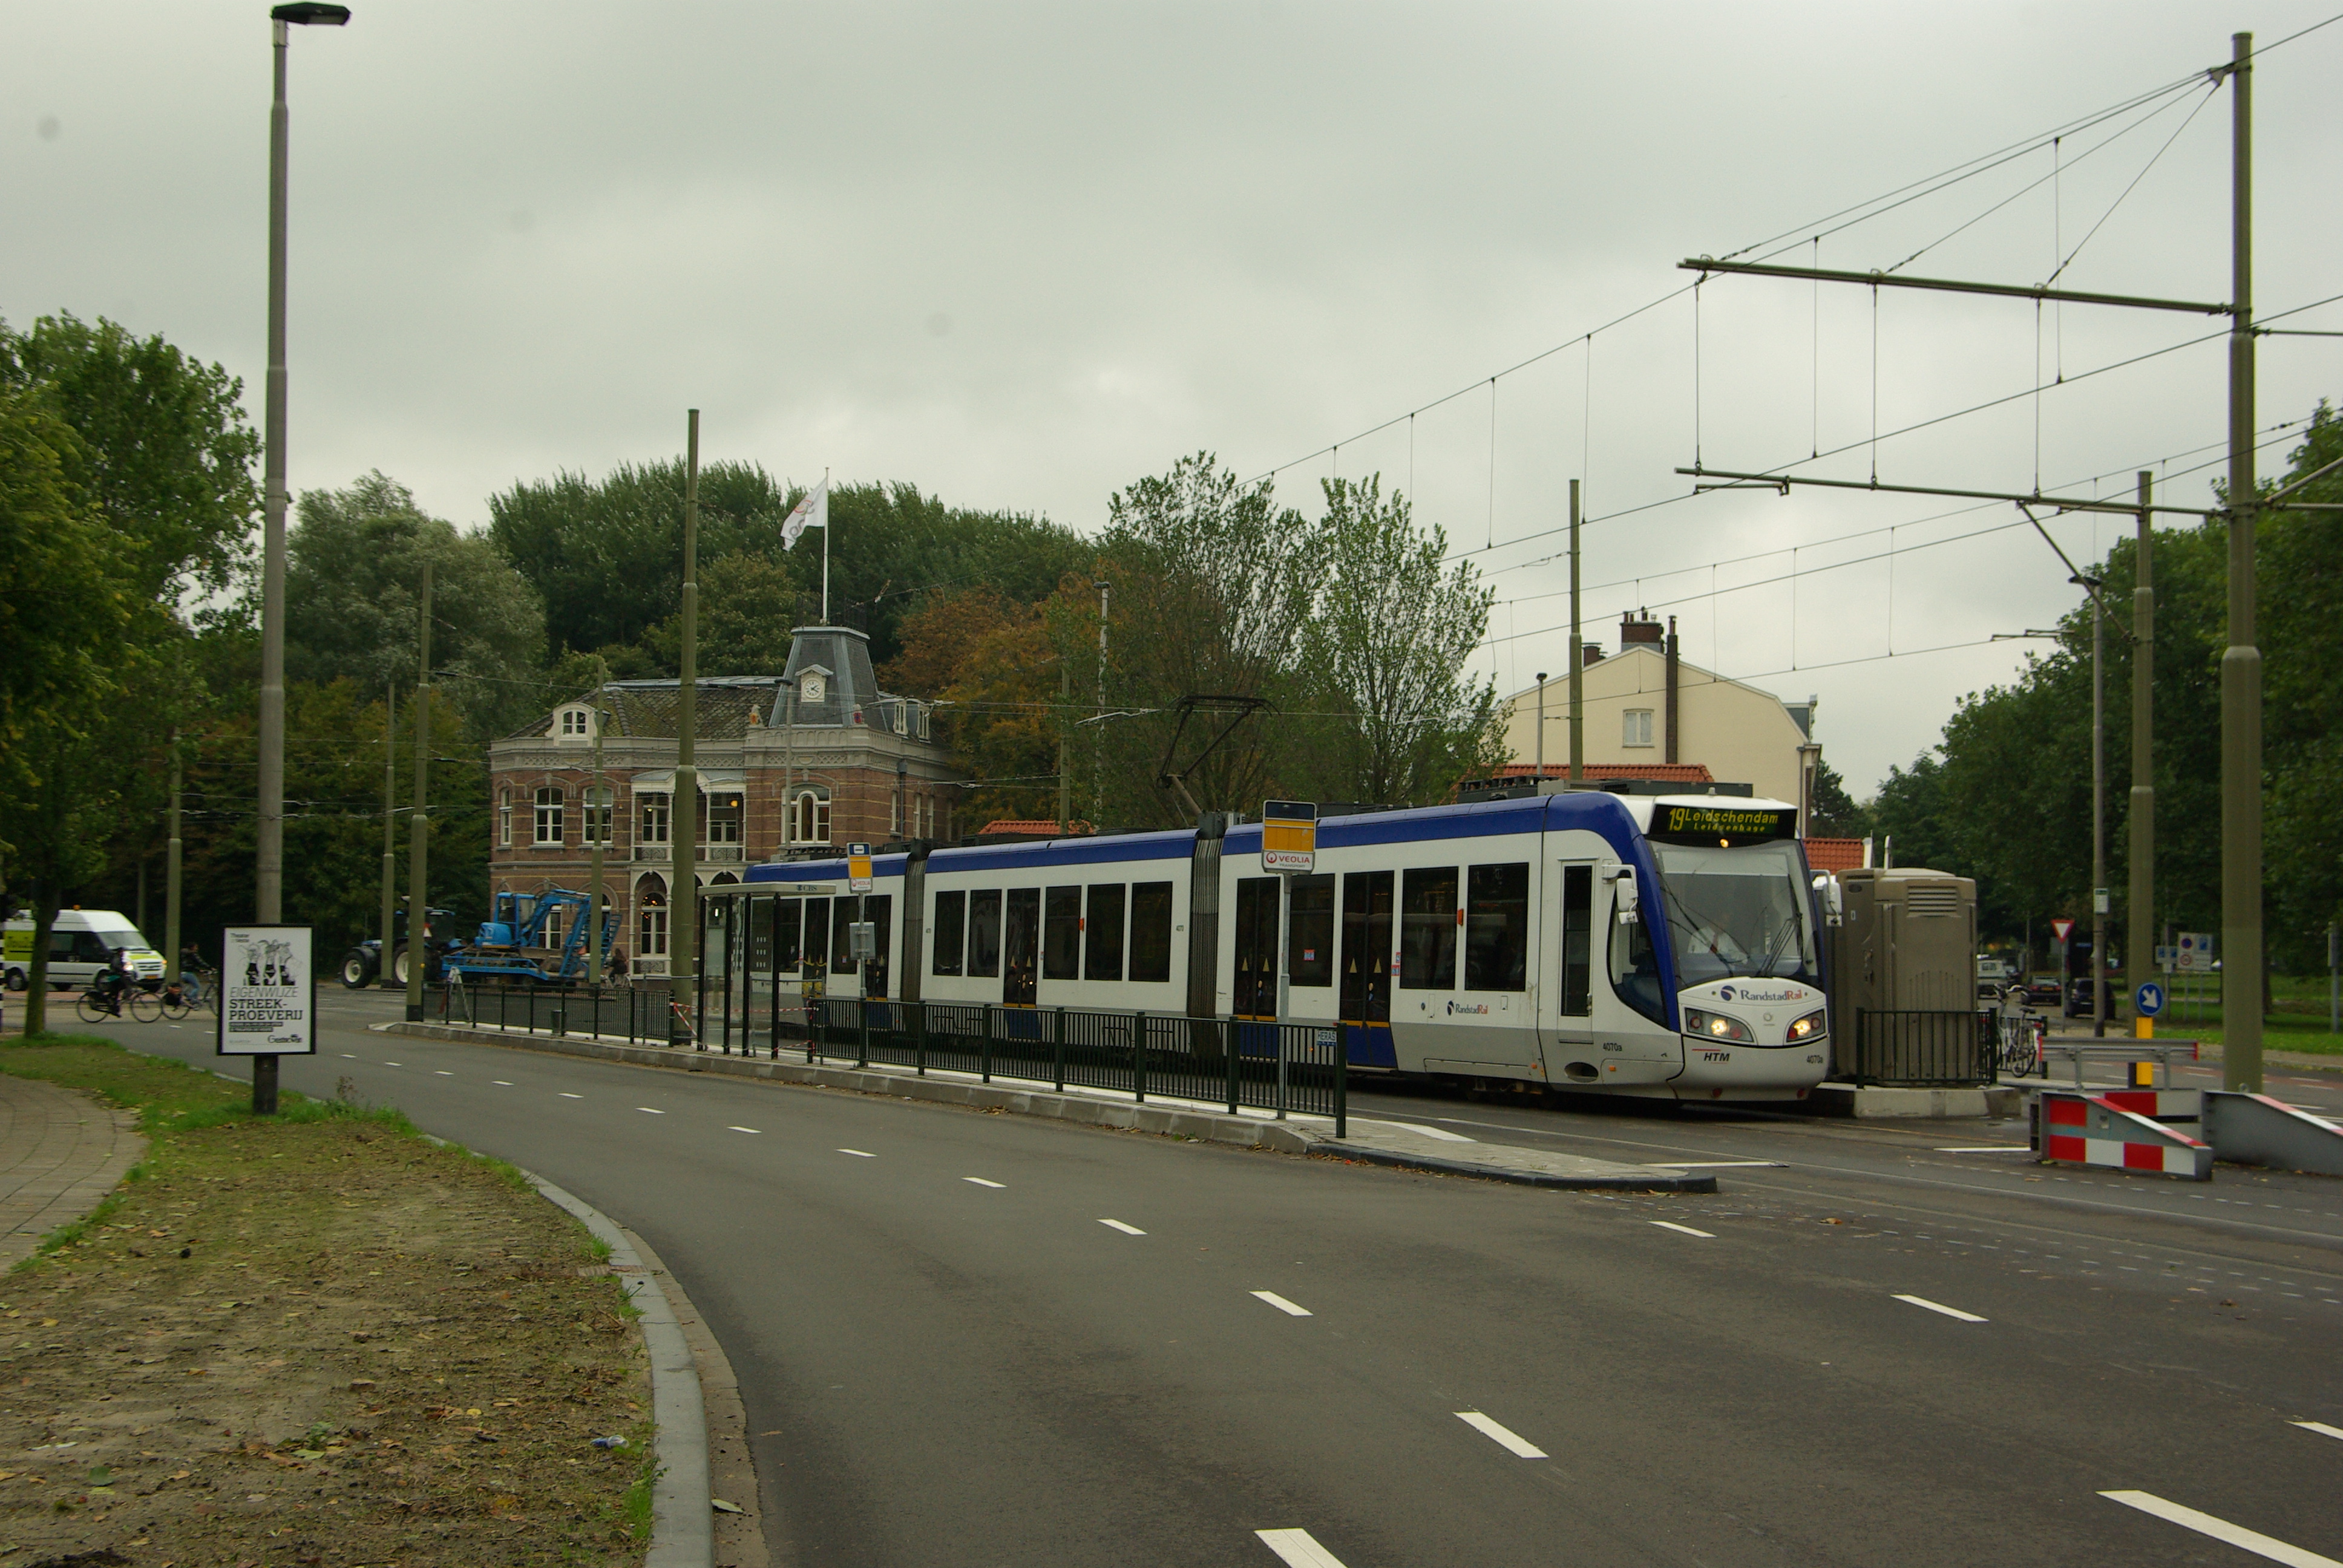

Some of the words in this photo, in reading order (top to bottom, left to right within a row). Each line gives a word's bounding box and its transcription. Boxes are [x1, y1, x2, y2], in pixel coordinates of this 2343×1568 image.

[1669, 808, 1686, 831] 19
[1685, 808, 1778, 824] Leidschendam
[230, 987, 299, 998] EIGENWIJZE
[1740, 989, 1802, 1001] RandstadRail
[229, 999, 287, 1009] STREEK-
[1455, 1003, 1488, 1014] RandstadRail
[229, 1010, 303, 1020] PROEVERIJ
[1603, 1042, 1622, 1051] 4070a
[1703, 1052, 1730, 1061] HTM
